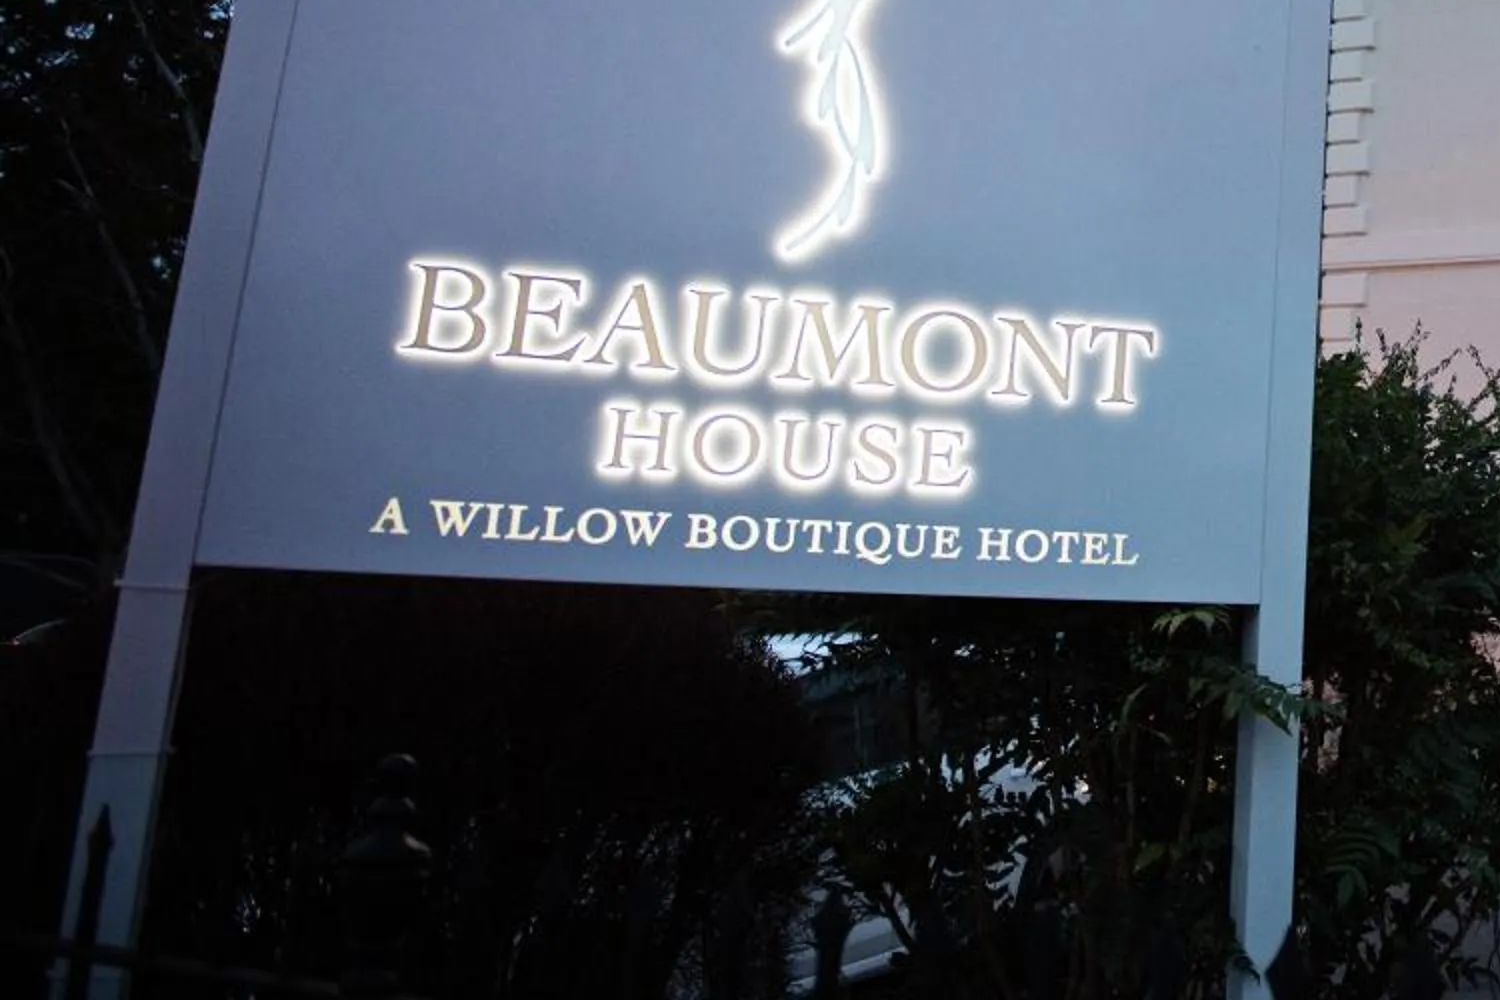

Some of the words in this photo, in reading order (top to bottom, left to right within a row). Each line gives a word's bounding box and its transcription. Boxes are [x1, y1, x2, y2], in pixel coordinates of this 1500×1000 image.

[400, 262, 1157, 405] BEAUMONT
[603, 407, 972, 488] HOUSE
[369, 497, 409, 536] A
[430, 501, 673, 547] WILLOW
[685, 514, 961, 566] BOUTIQUE
[977, 528, 1140, 566] HOTEL
